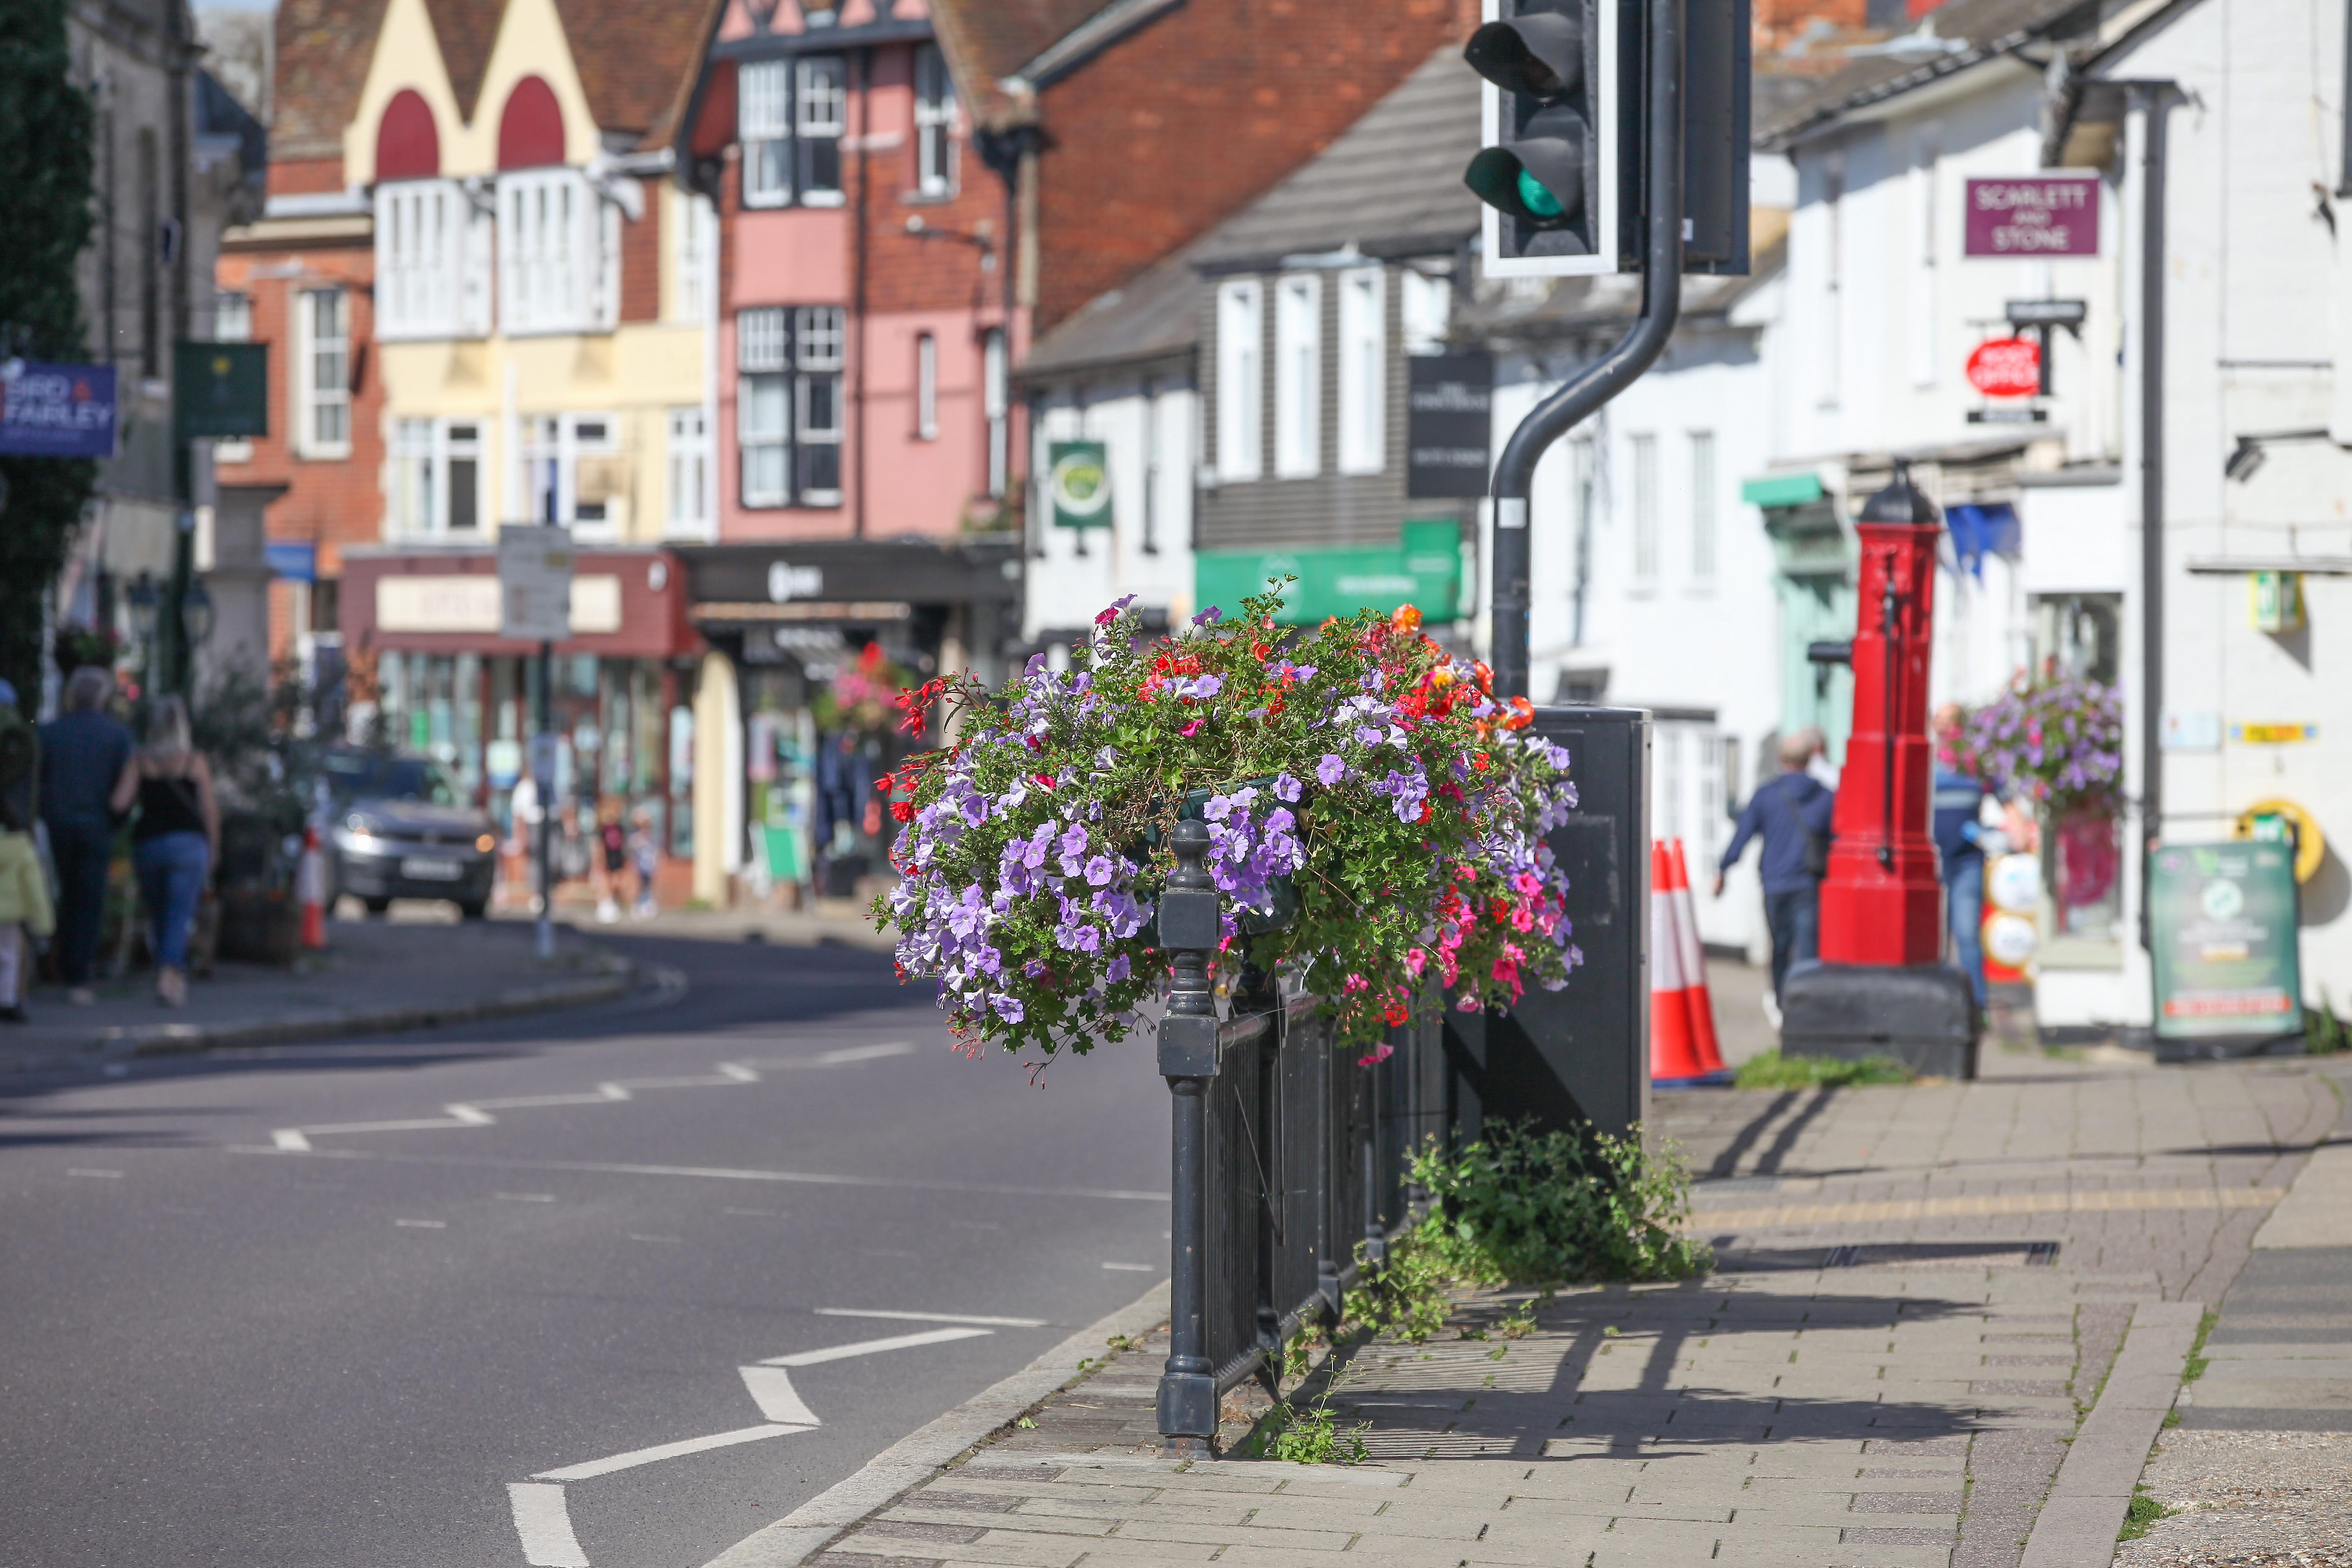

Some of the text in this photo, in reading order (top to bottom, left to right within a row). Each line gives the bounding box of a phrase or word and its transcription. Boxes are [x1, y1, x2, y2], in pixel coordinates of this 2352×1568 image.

[1975, 186, 2088, 209] SCARLETT
[2013, 210, 2050, 225] AND
[1993, 227, 2069, 249] STONE
